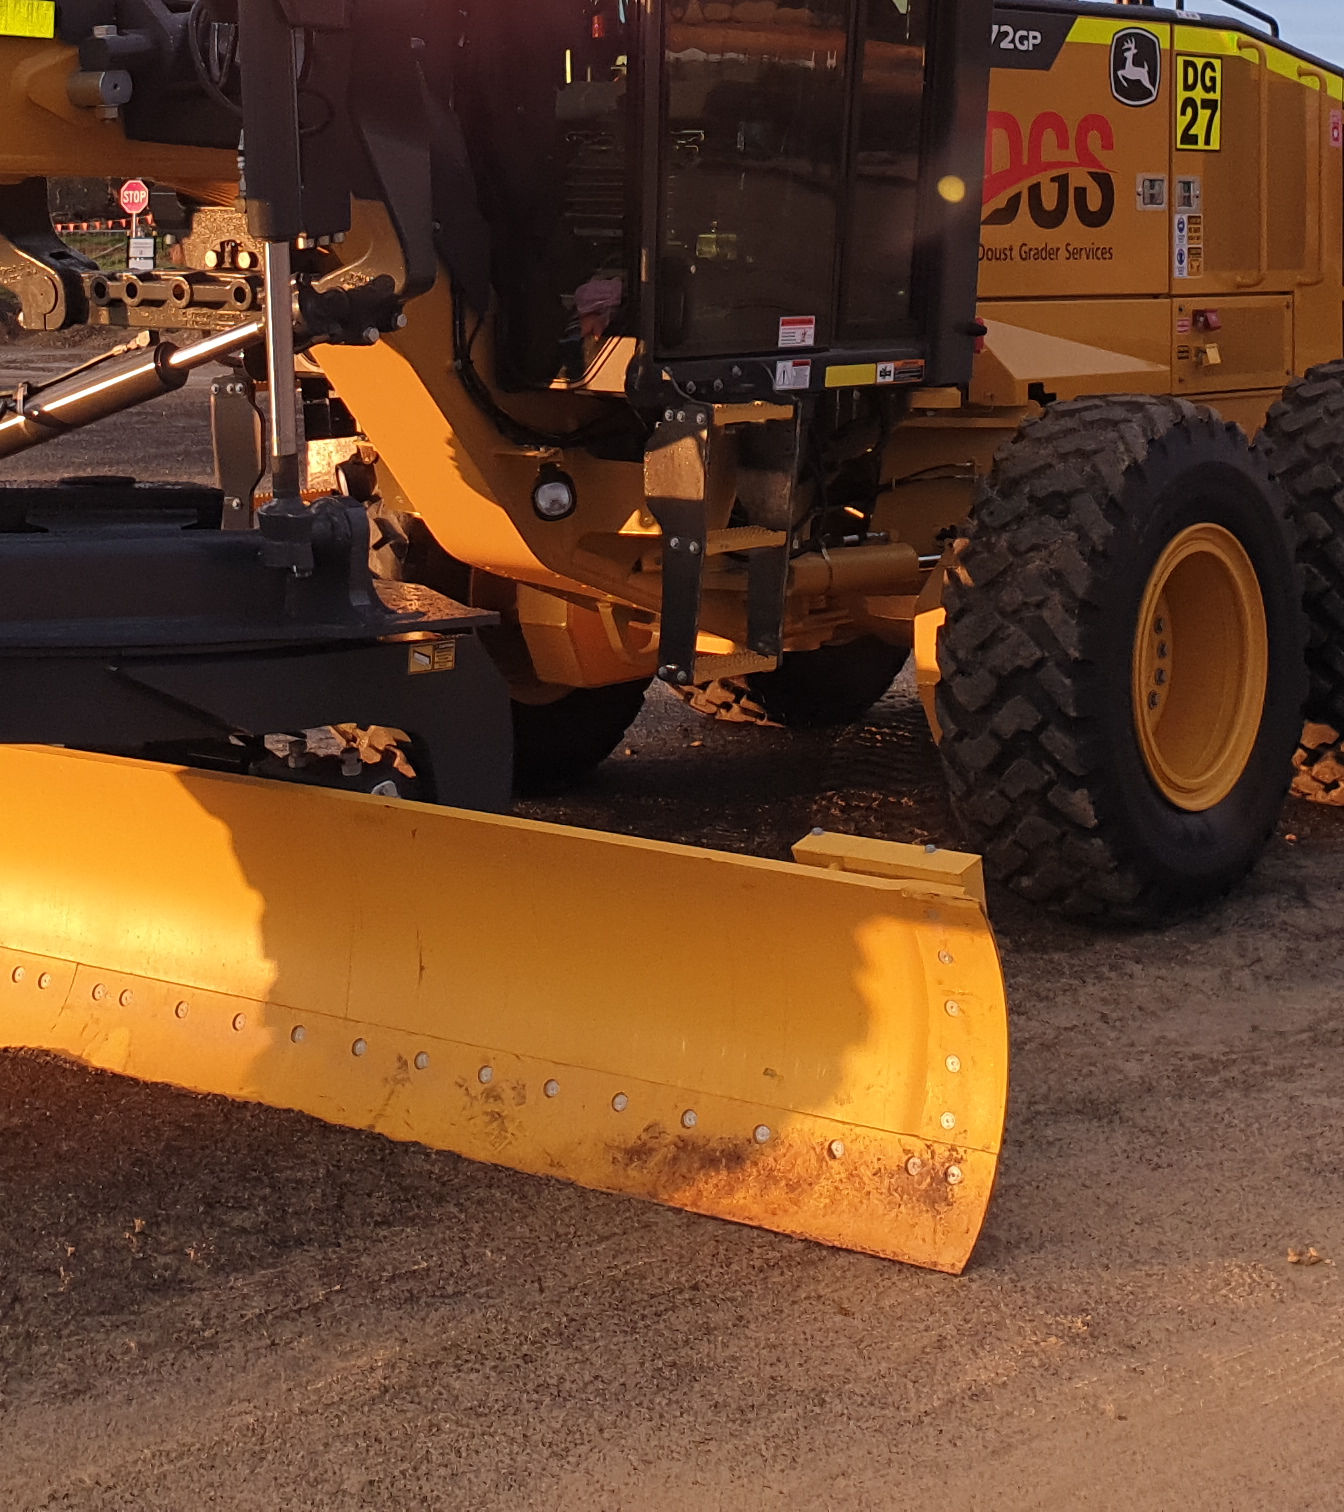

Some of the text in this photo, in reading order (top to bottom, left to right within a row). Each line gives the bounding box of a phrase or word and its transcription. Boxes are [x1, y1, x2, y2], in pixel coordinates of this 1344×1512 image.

[1182, 59, 1217, 94] DG
[1180, 97, 1219, 146] 27
[982, 110, 1116, 230] DGS
[122, 190, 147, 203] STOP
[1019, 242, 1060, 261] Grader
[1065, 242, 1113, 261] Services
